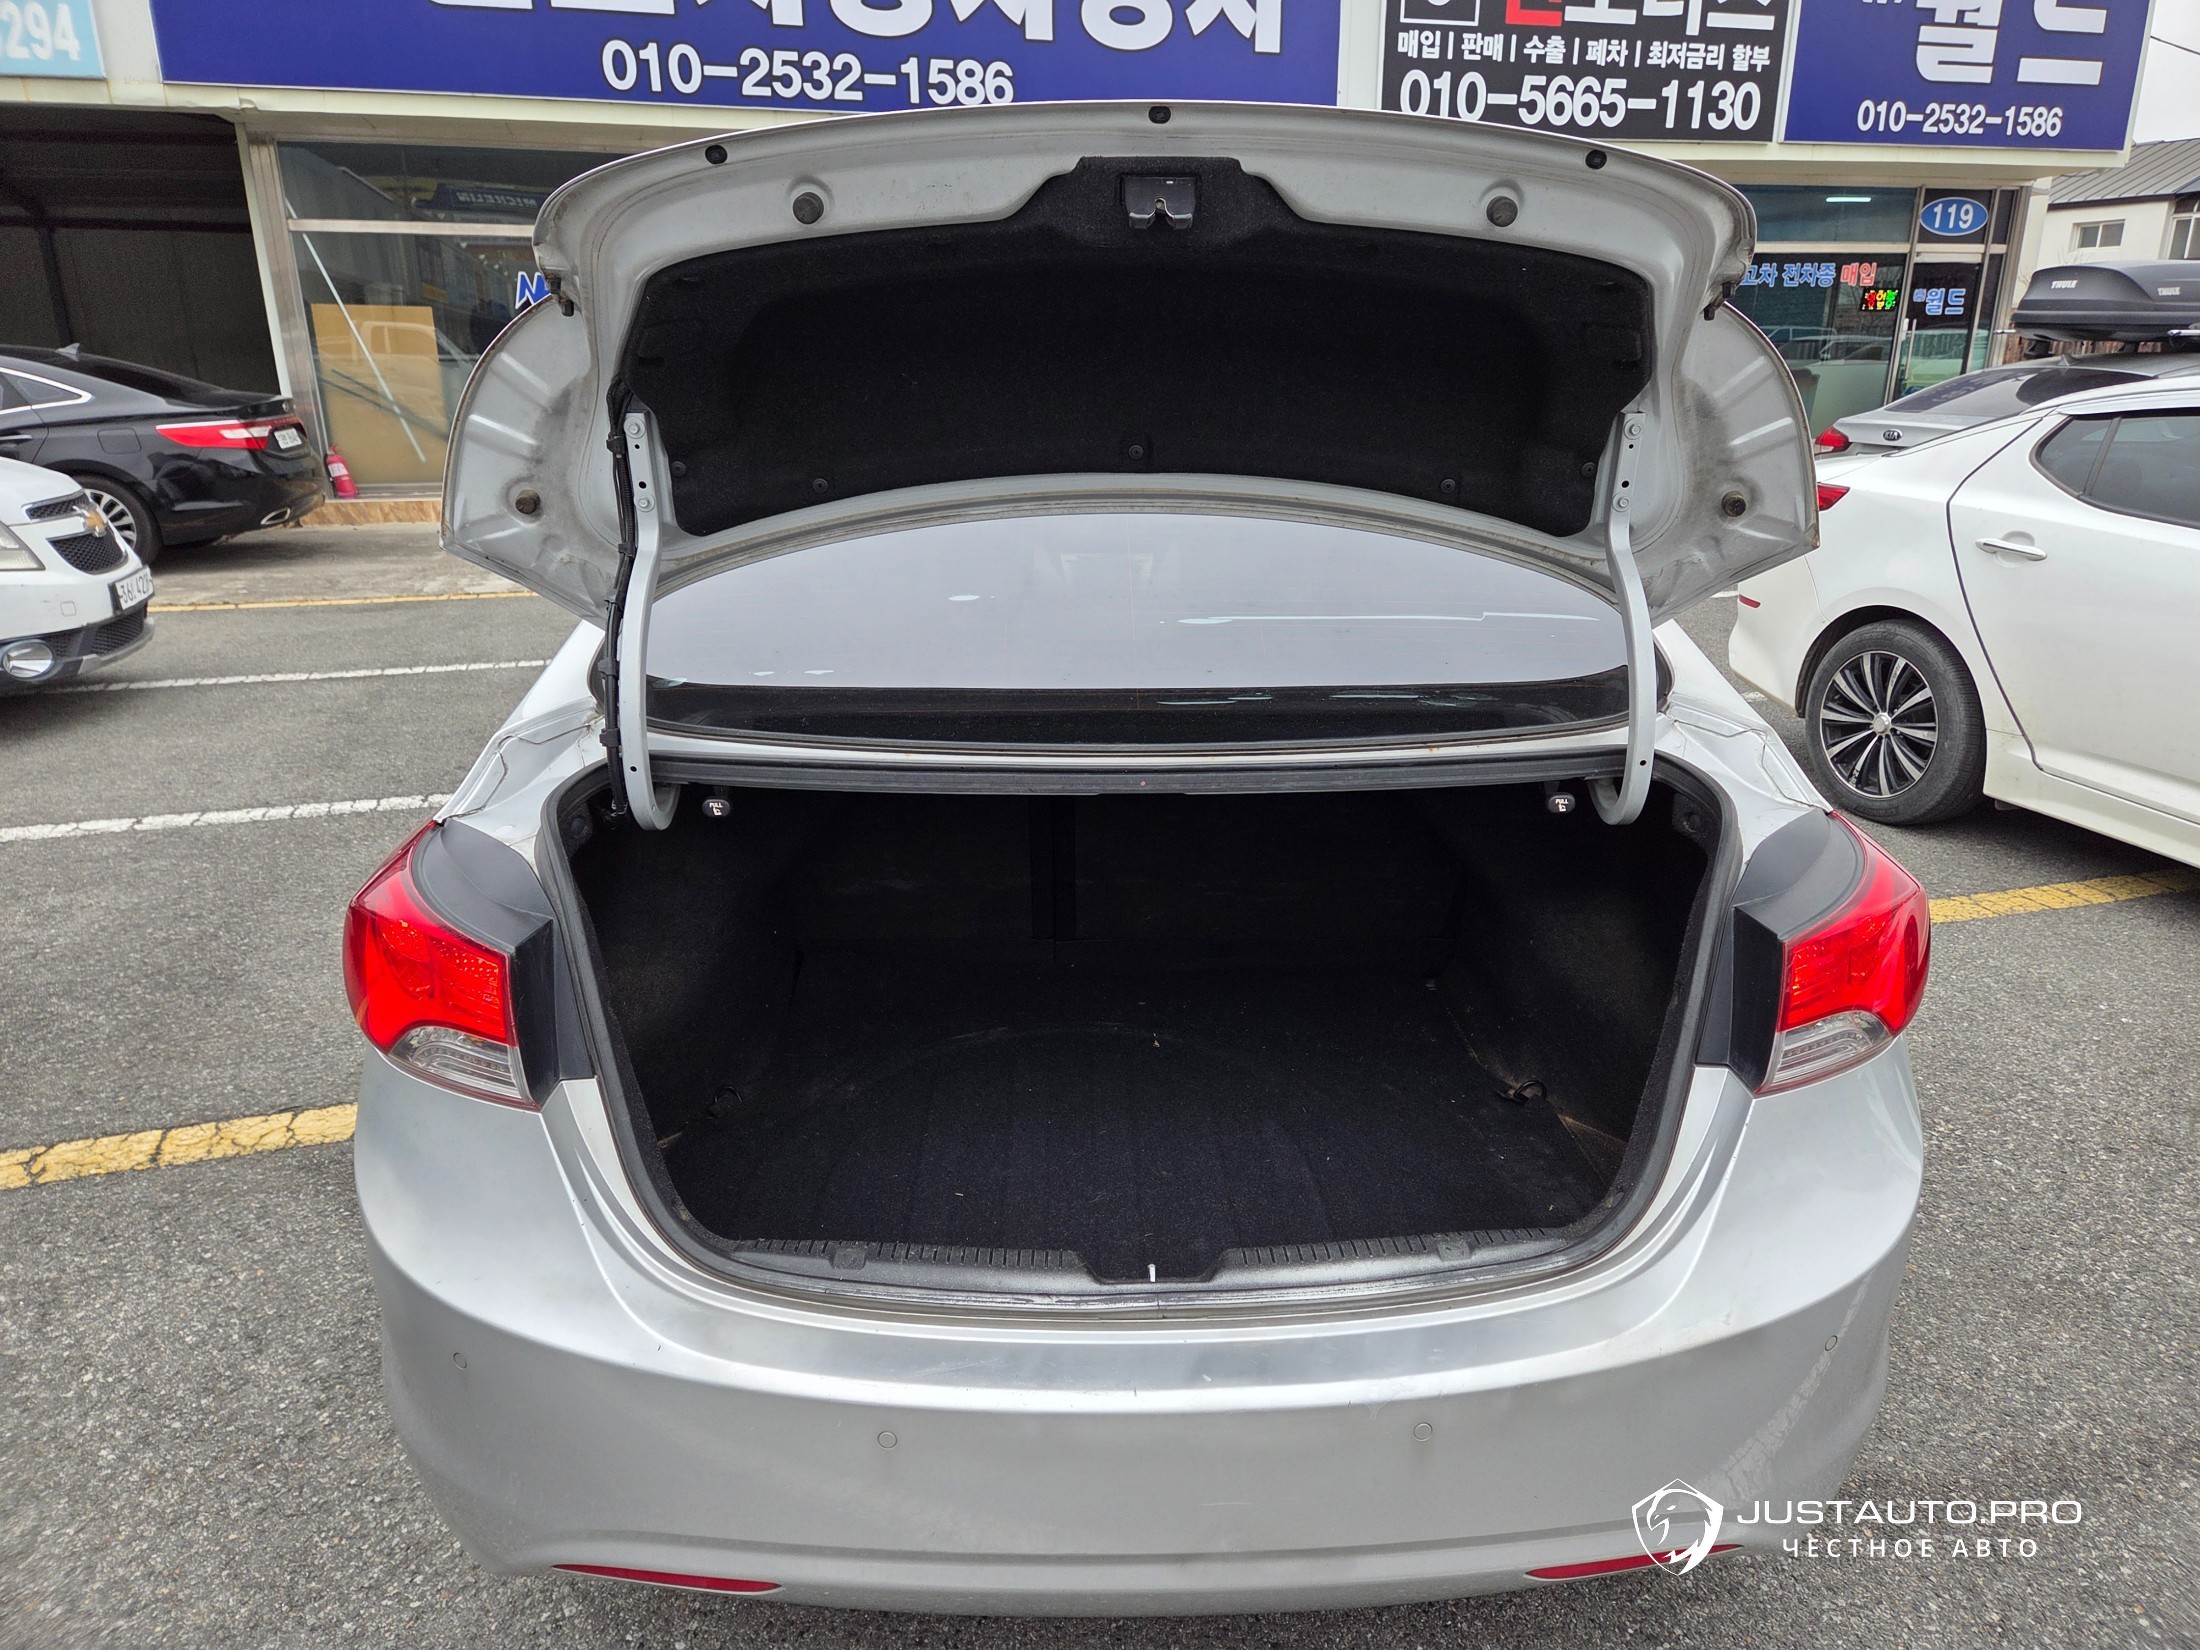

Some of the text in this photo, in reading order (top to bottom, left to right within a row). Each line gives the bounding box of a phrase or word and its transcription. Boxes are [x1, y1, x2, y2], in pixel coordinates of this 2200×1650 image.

[1398, 30, 1770, 72] 매입 판매 수출 폐차 최저금리 할부
[602, 39, 1014, 105] 010-2532-1586
[1400, 69, 1761, 131] 010-5665-1130
[1857, 100, 2063, 137] 010-2532-1586
[1933, 203, 1974, 229] 119
[1782, 262, 1836, 287] 전차종
[1840, 262, 1877, 287] 매입
[2051, 280, 2078, 289] THULE
